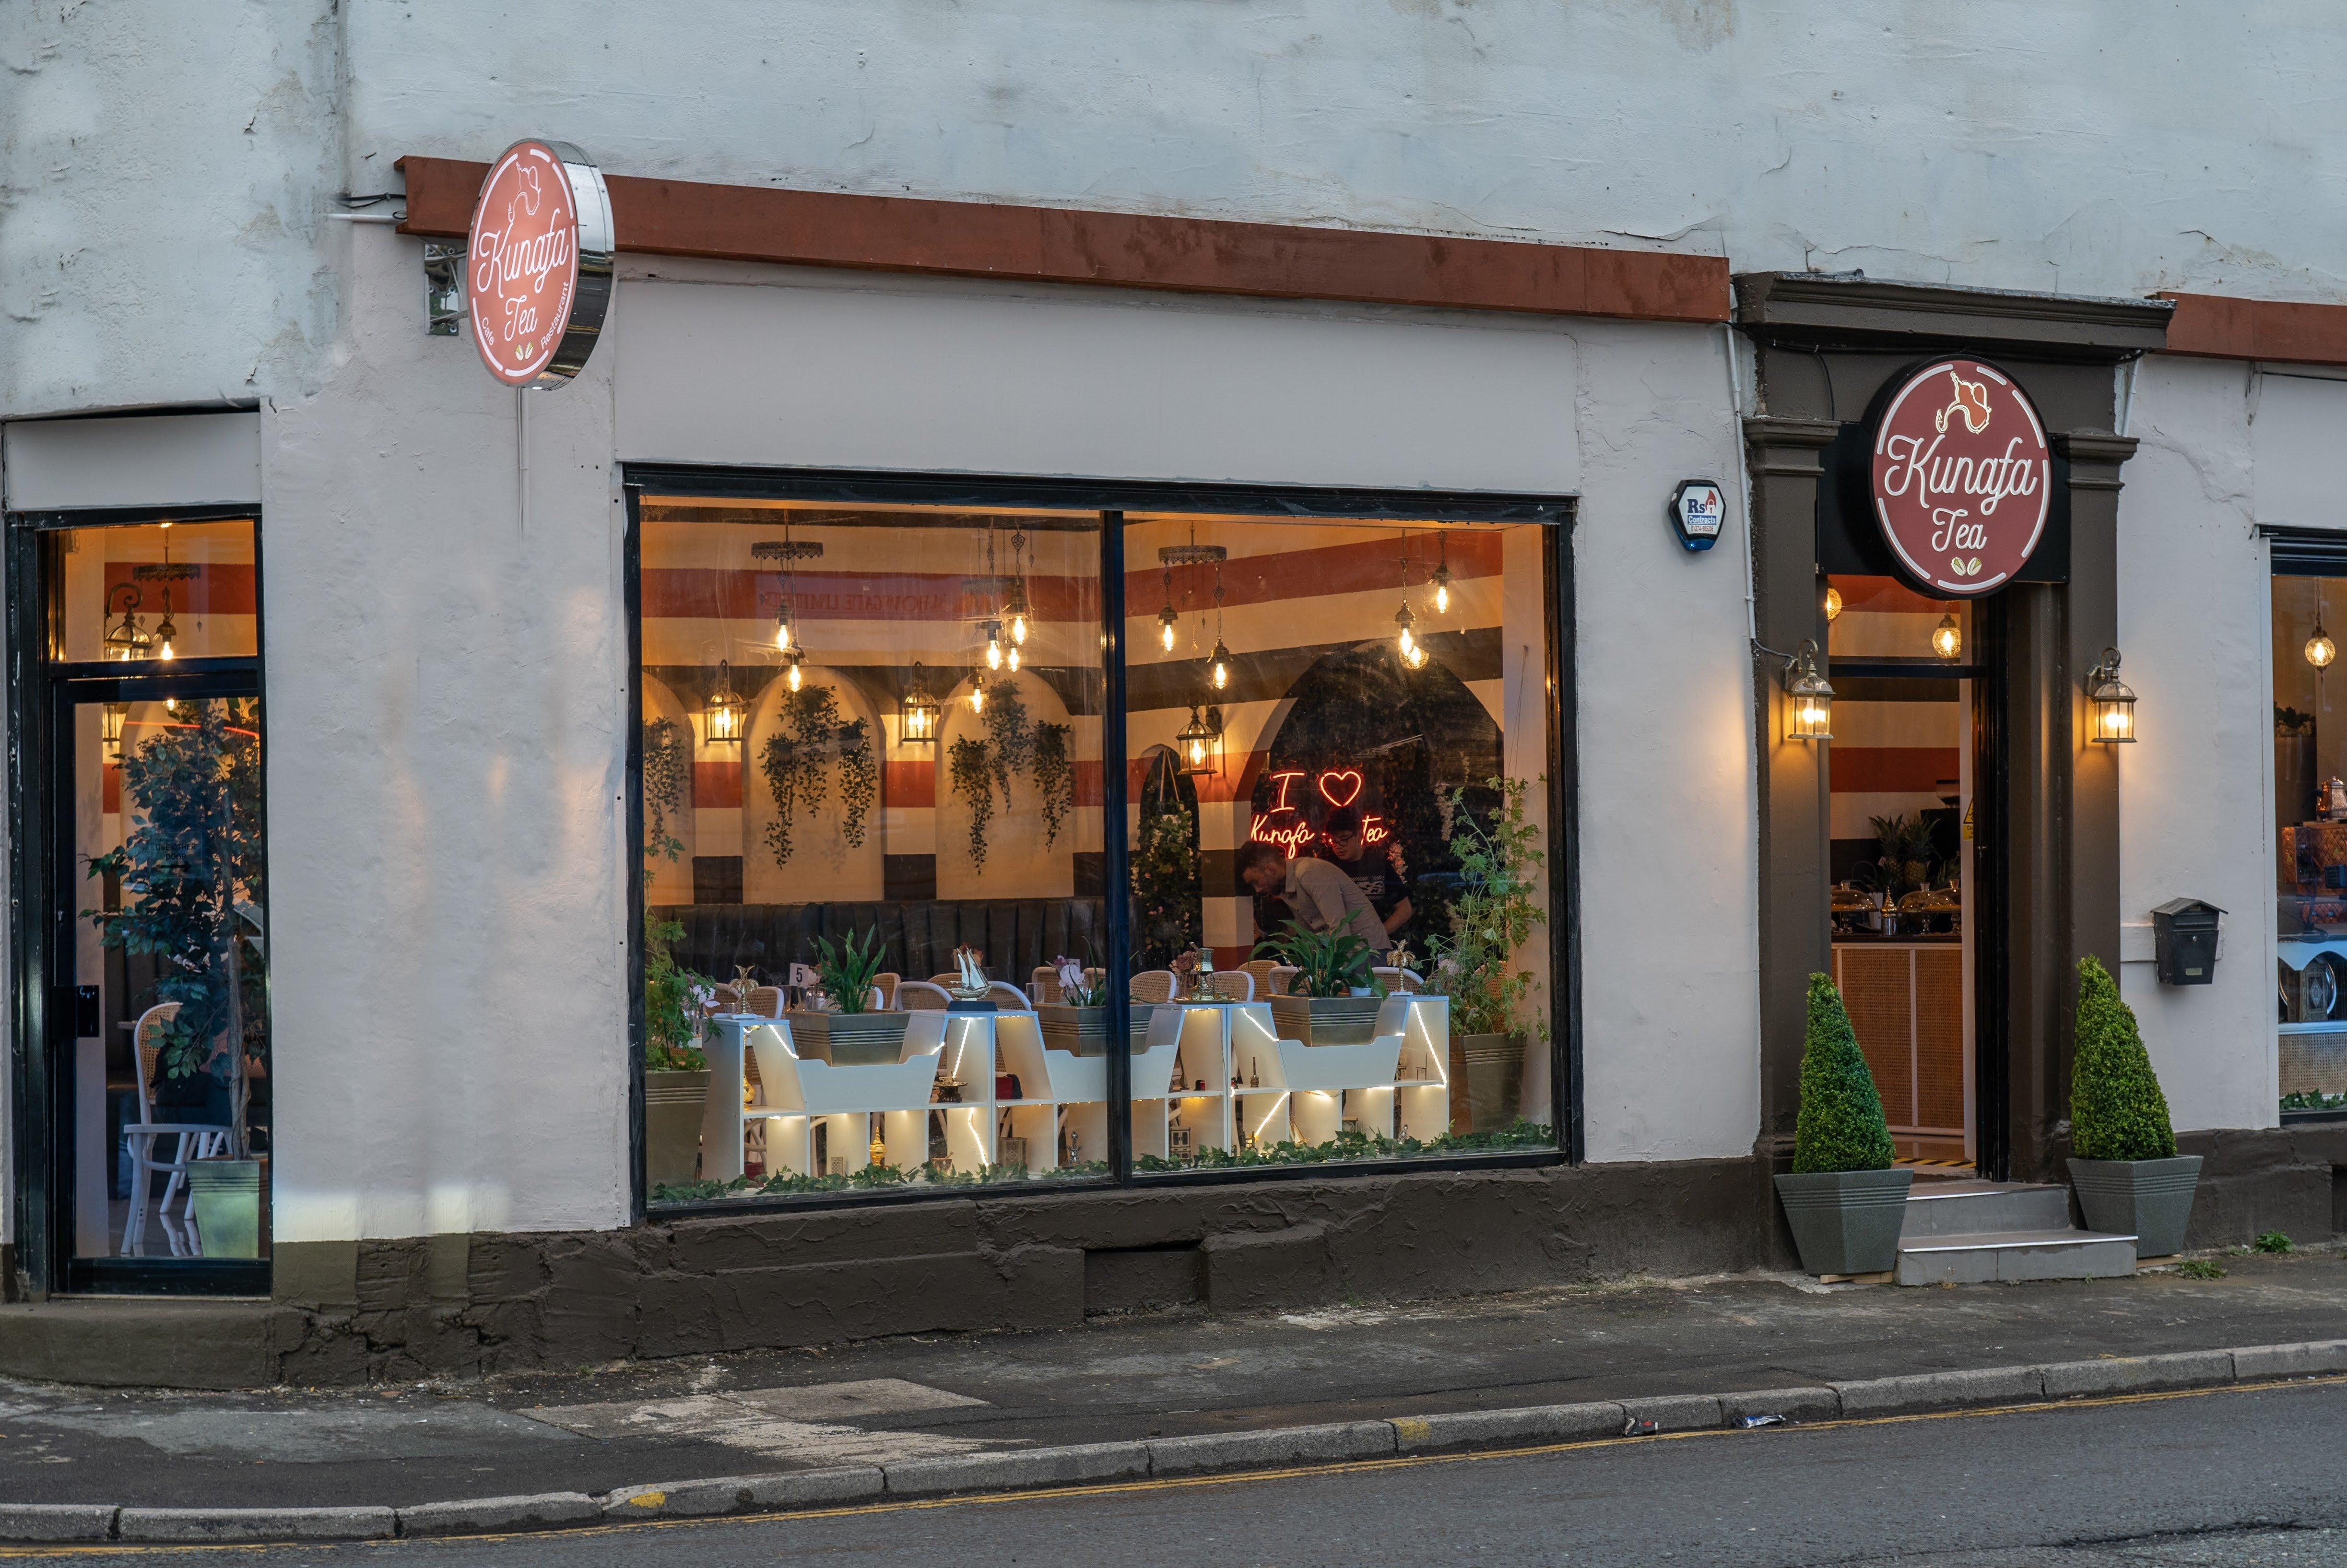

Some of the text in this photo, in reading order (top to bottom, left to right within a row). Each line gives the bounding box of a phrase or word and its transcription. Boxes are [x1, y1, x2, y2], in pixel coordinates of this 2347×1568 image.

[477, 208, 569, 298] Kunafa
[482, 317, 495, 346] Cafe
[505, 295, 538, 342] Tea
[540, 281, 569, 350] Restaurant
[1884, 434, 2038, 516] Kunafa
[1687, 499, 1705, 513] Rs
[1688, 515, 1716, 524] Contracts
[1932, 507, 1987, 552] Tea
[1270, 772, 1306, 813] I
[796, 967, 803, 983] 5
